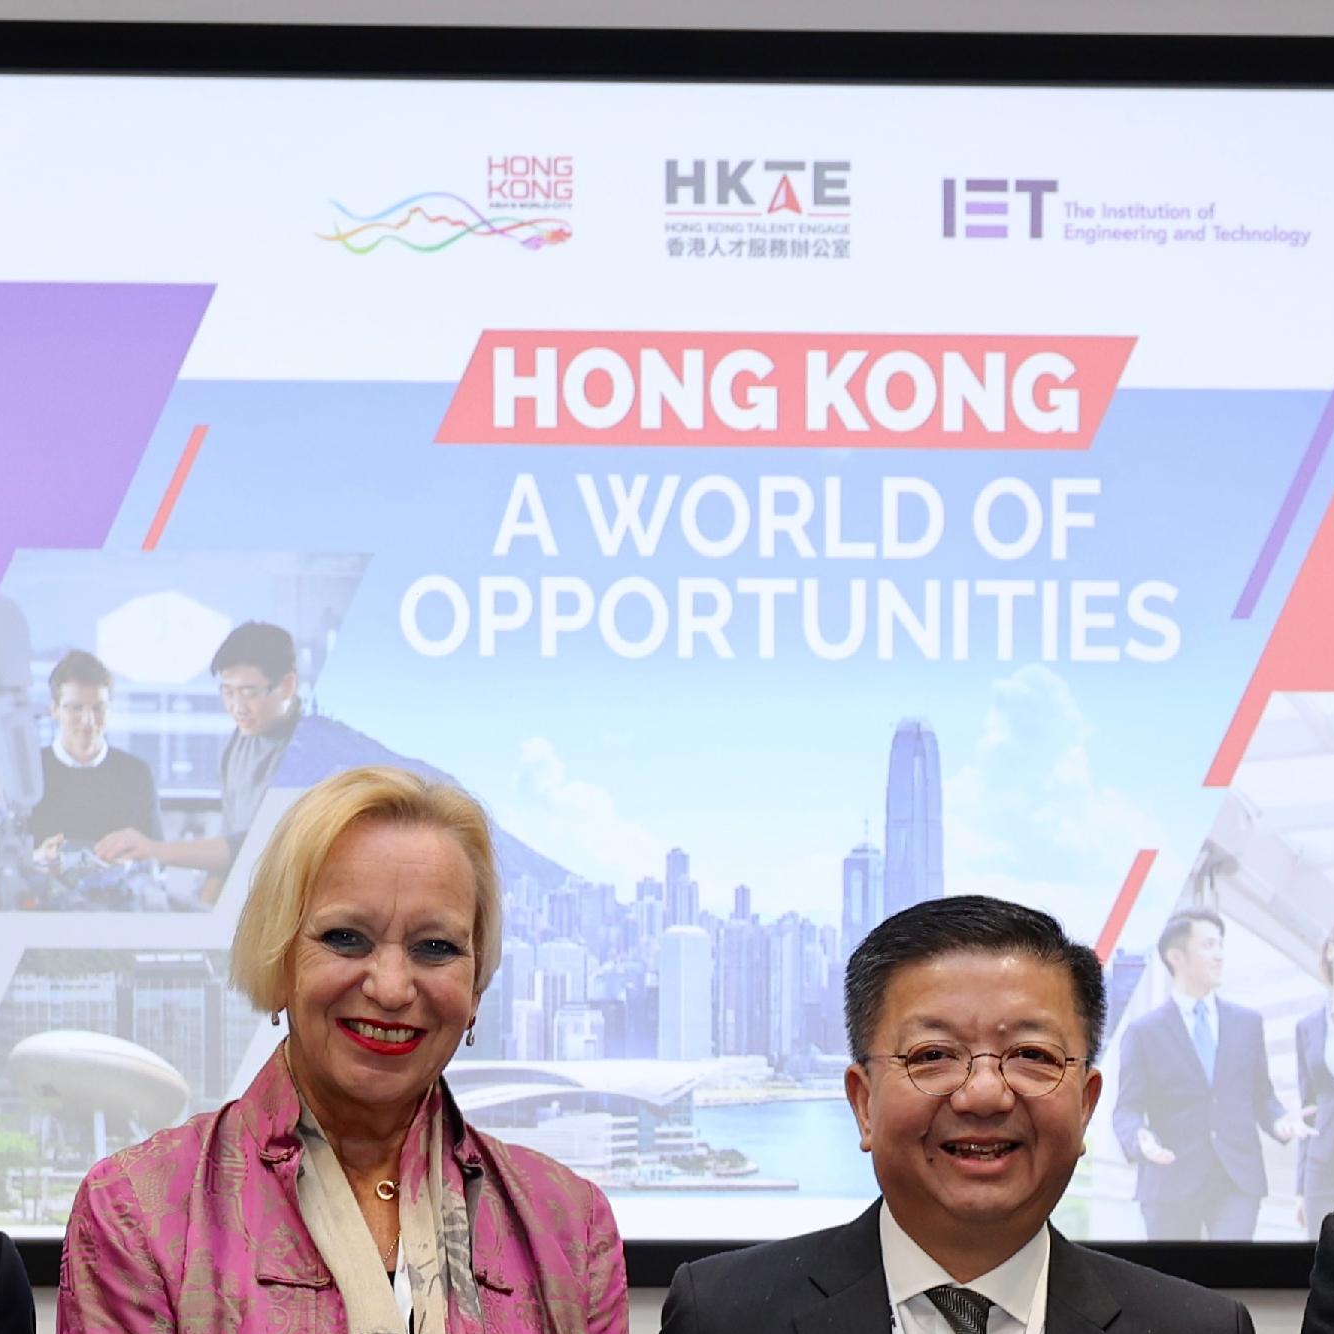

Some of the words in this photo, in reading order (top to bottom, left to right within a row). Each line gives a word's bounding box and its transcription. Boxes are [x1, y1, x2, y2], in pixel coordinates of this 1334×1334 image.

[488, 155, 573, 176] HONG
[488, 179, 573, 200] KONG
[943, 178, 1058, 239] IET
[1063, 202, 1095, 220] The
[1101, 202, 1190, 220] Institution
[1197, 202, 1216, 220] of
[665, 222, 703, 234] HONG
[707, 222, 744, 234] KONG
[747, 222, 795, 235] TALENT
[799, 222, 851, 235] ENGAGE
[1063, 224, 1167, 244] Engineering
[1173, 225, 1206, 242] and
[1213, 225, 1311, 247] Technology
[667, 237, 851, 259] 香港人才服務辦公室
[491, 345, 778, 432] HONG
[805, 349, 1080, 435] KONG
[492, 474, 560, 556] A
[575, 475, 945, 560] WORLD
[971, 478, 1102, 561] OF
[399, 574, 1182, 663] OPPORTUNITIES
